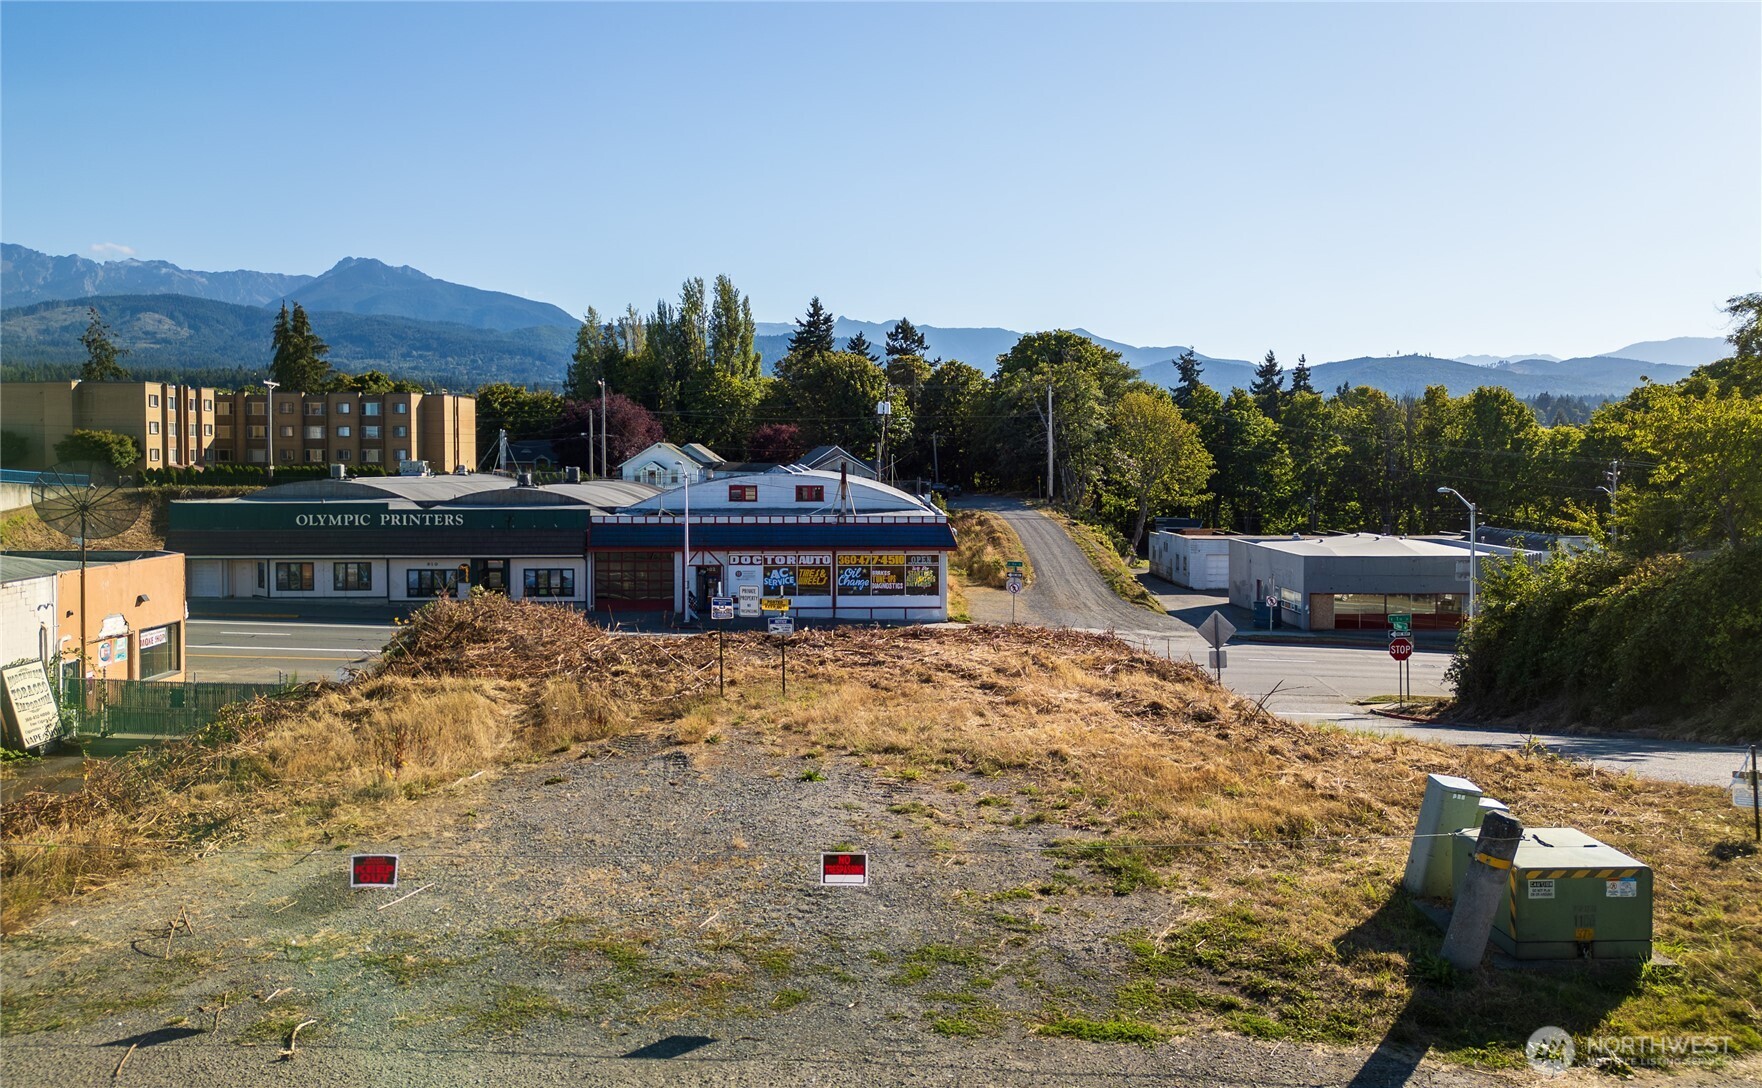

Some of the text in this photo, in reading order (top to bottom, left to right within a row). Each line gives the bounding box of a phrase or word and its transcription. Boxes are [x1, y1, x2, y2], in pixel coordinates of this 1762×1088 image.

[296, 514, 464, 526] OLYMPIC PRINTERS
[730, 555, 831, 565] DOCTOR AUTO
[770, 568, 789, 579] AC
[799, 569, 819, 577] TIRES
[844, 567, 862, 578] Oil
[763, 576, 795, 586] SERVICE
[798, 577, 828, 585] WHEELS
[838, 574, 870, 590] Change
[1390, 645, 1411, 654] STOP
[11, 681, 49, 701] TOBACCO
[15, 693, 53, 712] EMPORIUM
[25, 733, 42, 745] VAPE
[44, 726, 62, 740] SHOP
[838, 855, 851, 865] NO
[355, 865, 394, 874] KEEP
[825, 865, 865, 874] TRESPASSING
[359, 873, 390, 883] OUT
